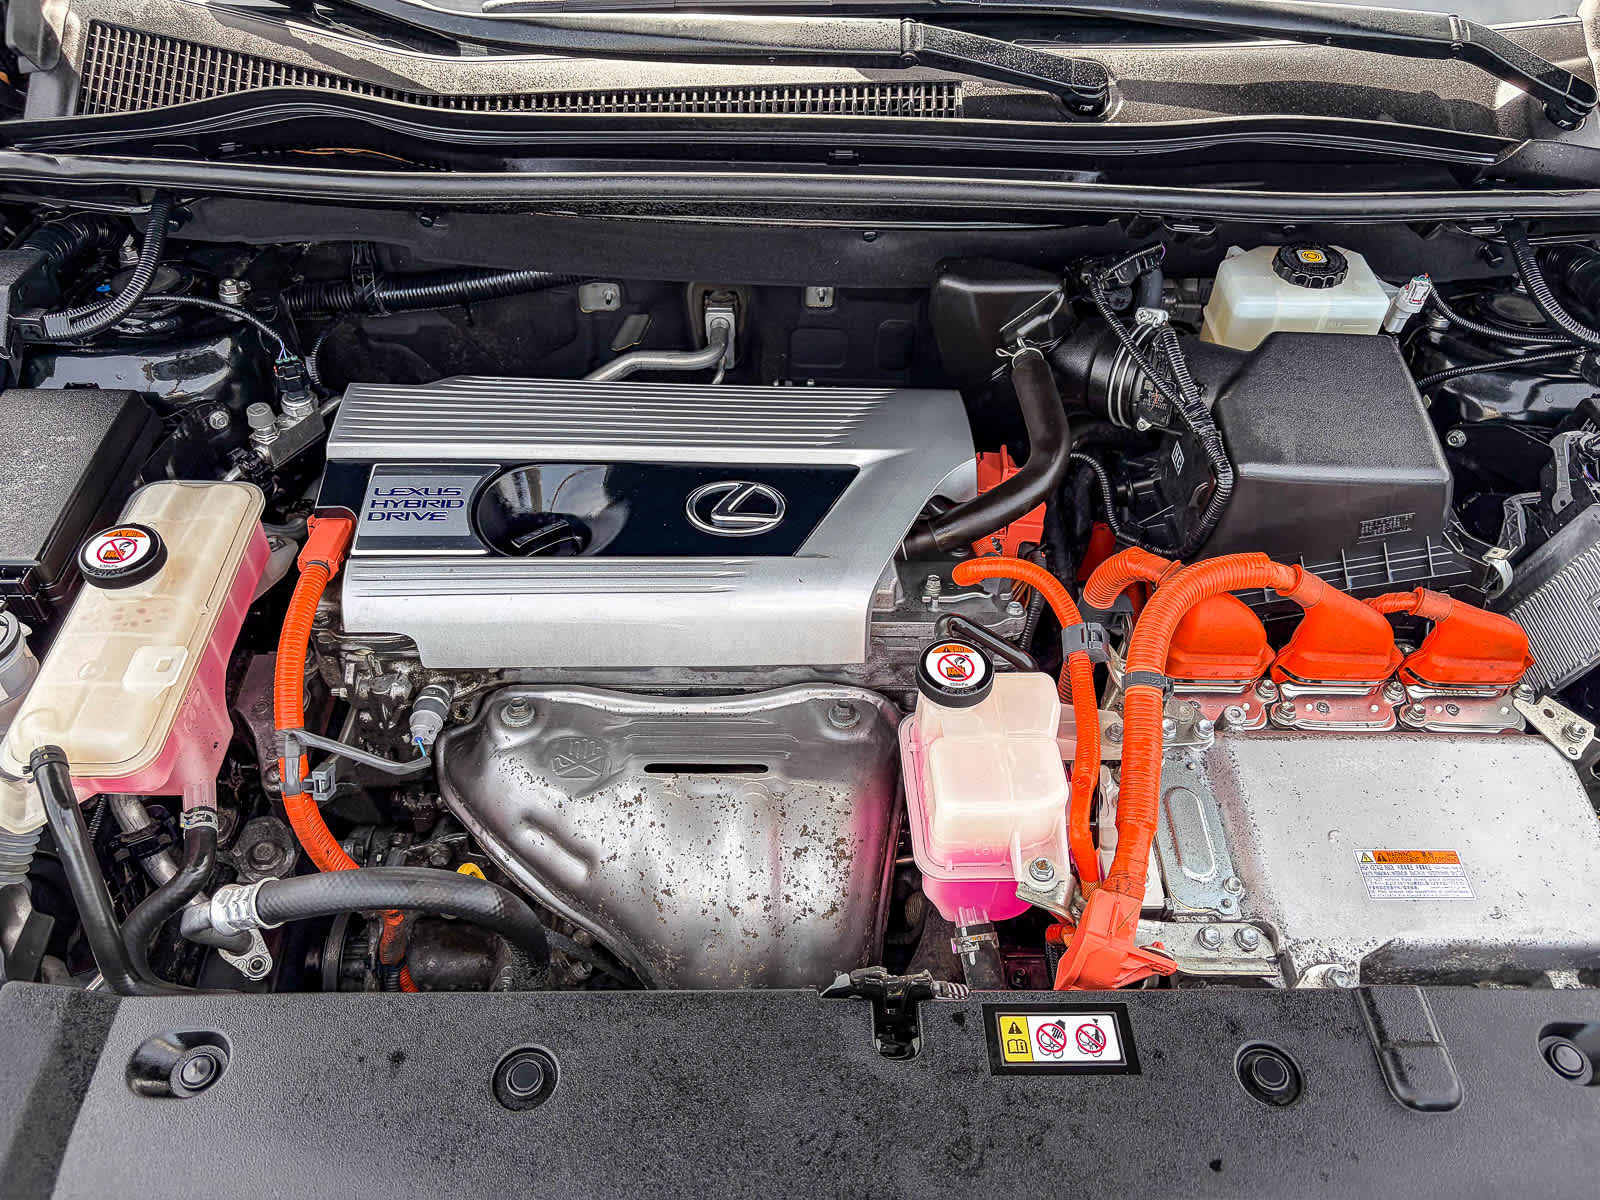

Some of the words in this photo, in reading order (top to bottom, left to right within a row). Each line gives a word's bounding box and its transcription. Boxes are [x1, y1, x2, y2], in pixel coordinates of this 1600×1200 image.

[373, 487, 462, 497] LEXUS
[370, 499, 465, 509] HYBRID
[367, 511, 449, 521] DRIVE
